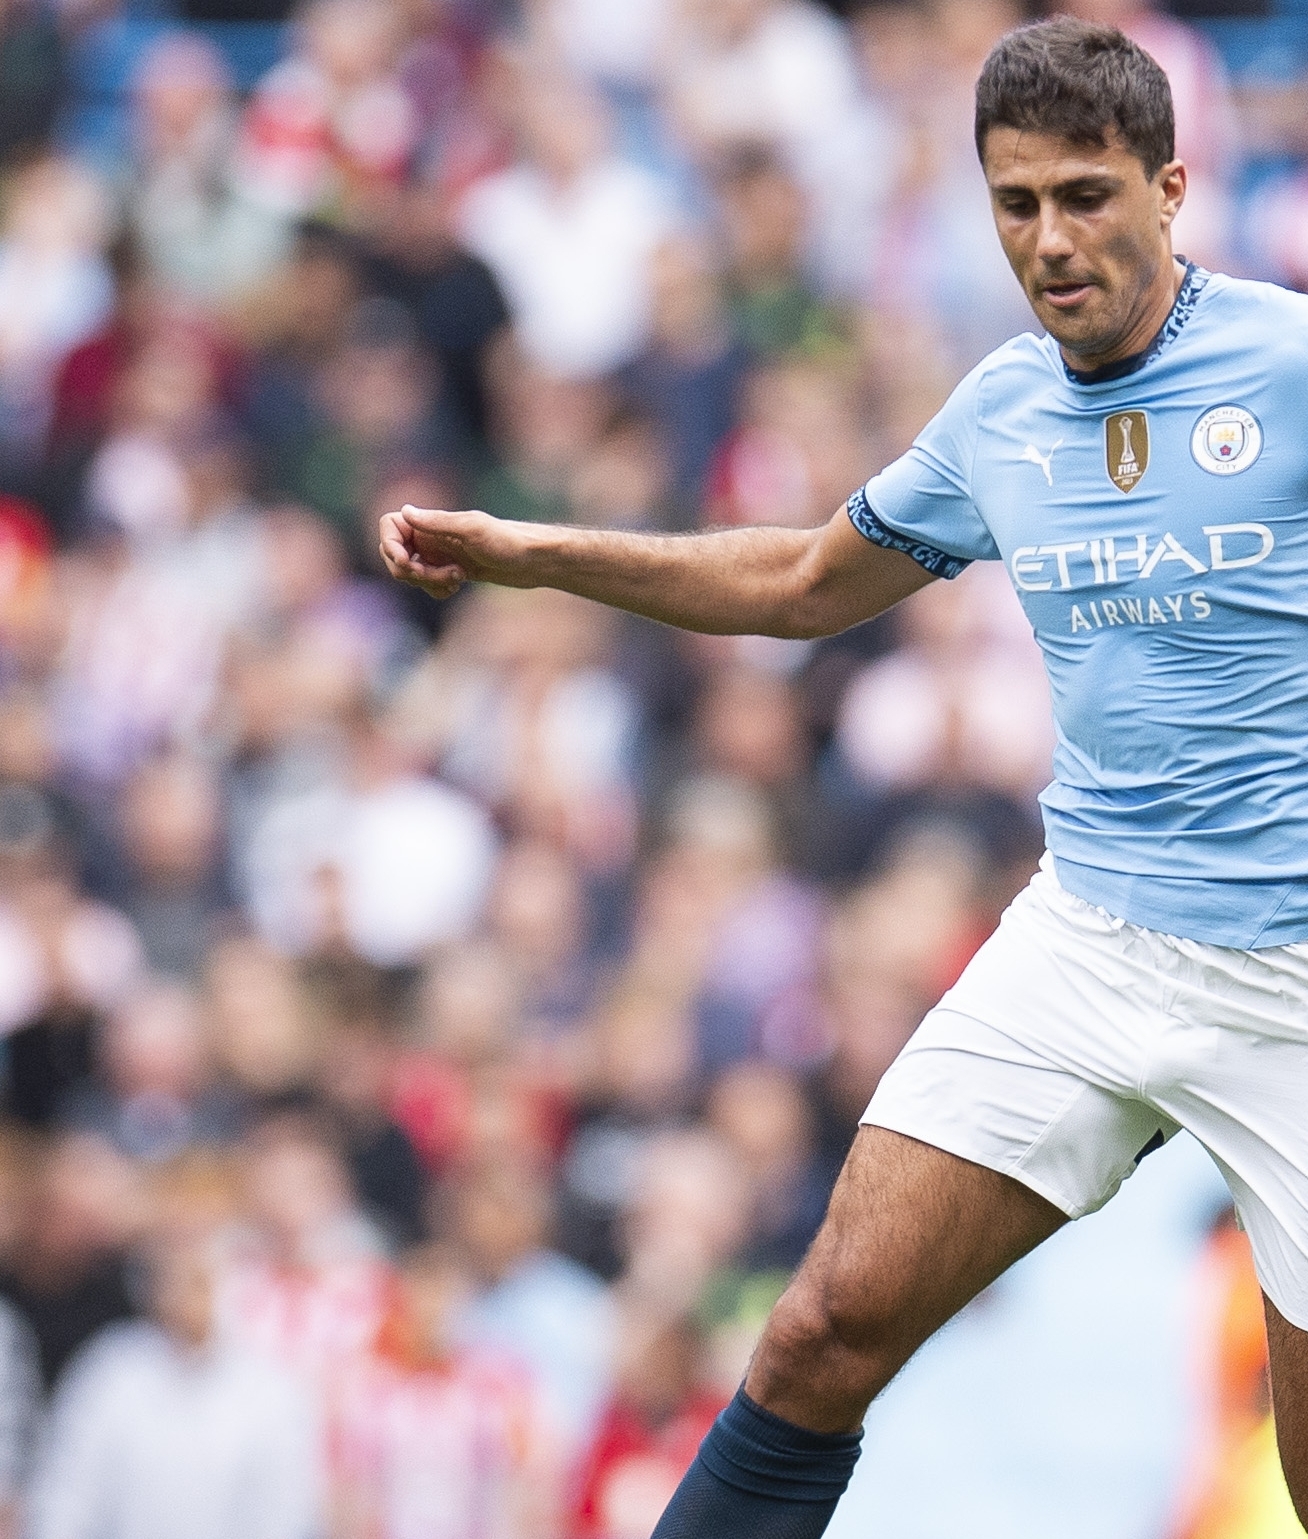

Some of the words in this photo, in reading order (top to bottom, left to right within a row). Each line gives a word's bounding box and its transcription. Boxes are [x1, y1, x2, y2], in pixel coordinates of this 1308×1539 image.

[1198, 409, 1255, 432] MANCHESTER
[1117, 462, 1138, 476] FIFA
[1215, 463, 1237, 472] CITY
[1011, 522, 1275, 591] ETIHAD
[1071, 590, 1212, 633] AIRWAYS
